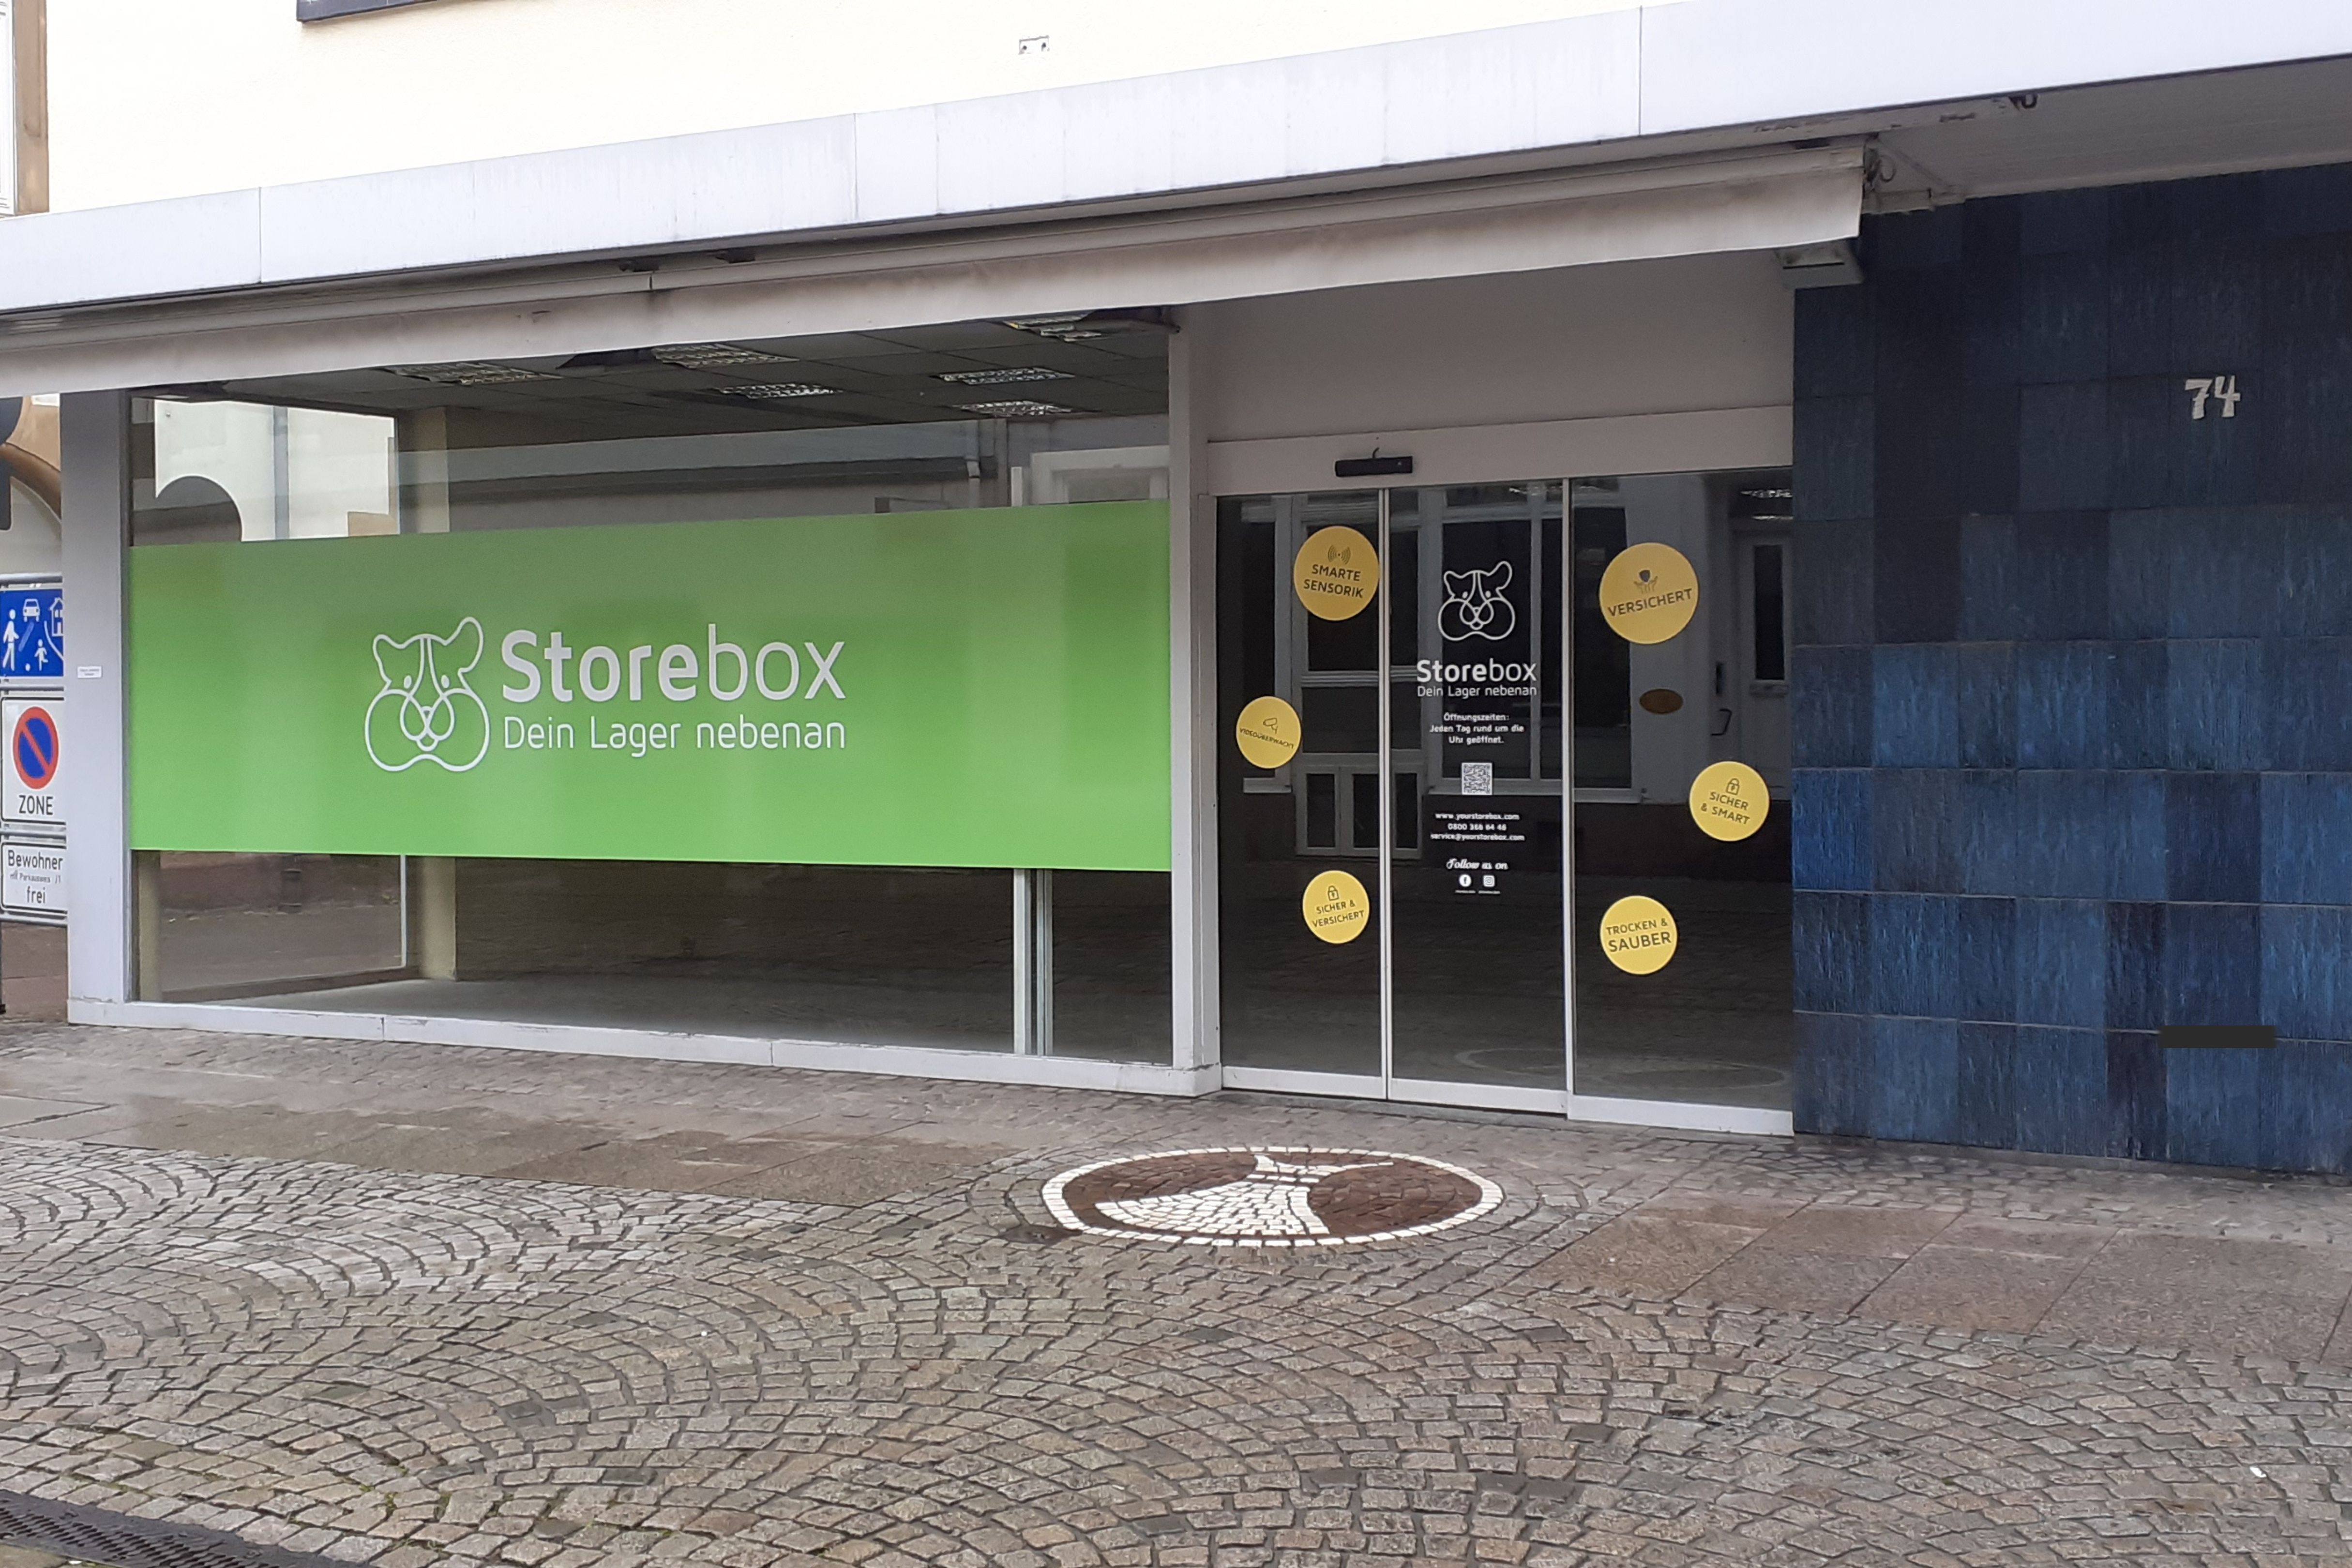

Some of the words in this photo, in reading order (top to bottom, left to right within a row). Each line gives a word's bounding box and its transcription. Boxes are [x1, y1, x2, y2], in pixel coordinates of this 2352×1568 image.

[2185, 375, 2241, 419] 74
[1312, 564, 1361, 581] SMARTE
[1303, 579, 1364, 599] SENSORIK
[1607, 588, 1692, 617] VERSICHERT
[501, 623, 845, 702] Storebox
[1417, 658, 1537, 682] Storebox
[1417, 686, 1443, 697] Dein
[1448, 686, 1480, 699] Lager
[1485, 685, 1537, 696] nebenan
[504, 716, 573, 749] Dein
[590, 716, 681, 757] Lager
[697, 715, 845, 749] nebenan
[1456, 724, 1471, 734] Tag
[19, 795, 53, 815] ZONE
[1709, 791, 1749, 811] SICHER
[1701, 803, 1707, 812] &
[1712, 806, 1750, 825] SMART
[8, 850, 63, 870] Bewohner
[1446, 858, 1480, 870] Follow
[27, 886, 45, 904] frei
[1316, 901, 1346, 914] SICHER
[1312, 910, 1364, 927] VERSICHERT
[1606, 920, 1657, 935] TROCKEN
[1661, 918, 1668, 926] &
[1608, 931, 1672, 952] SAUBER
